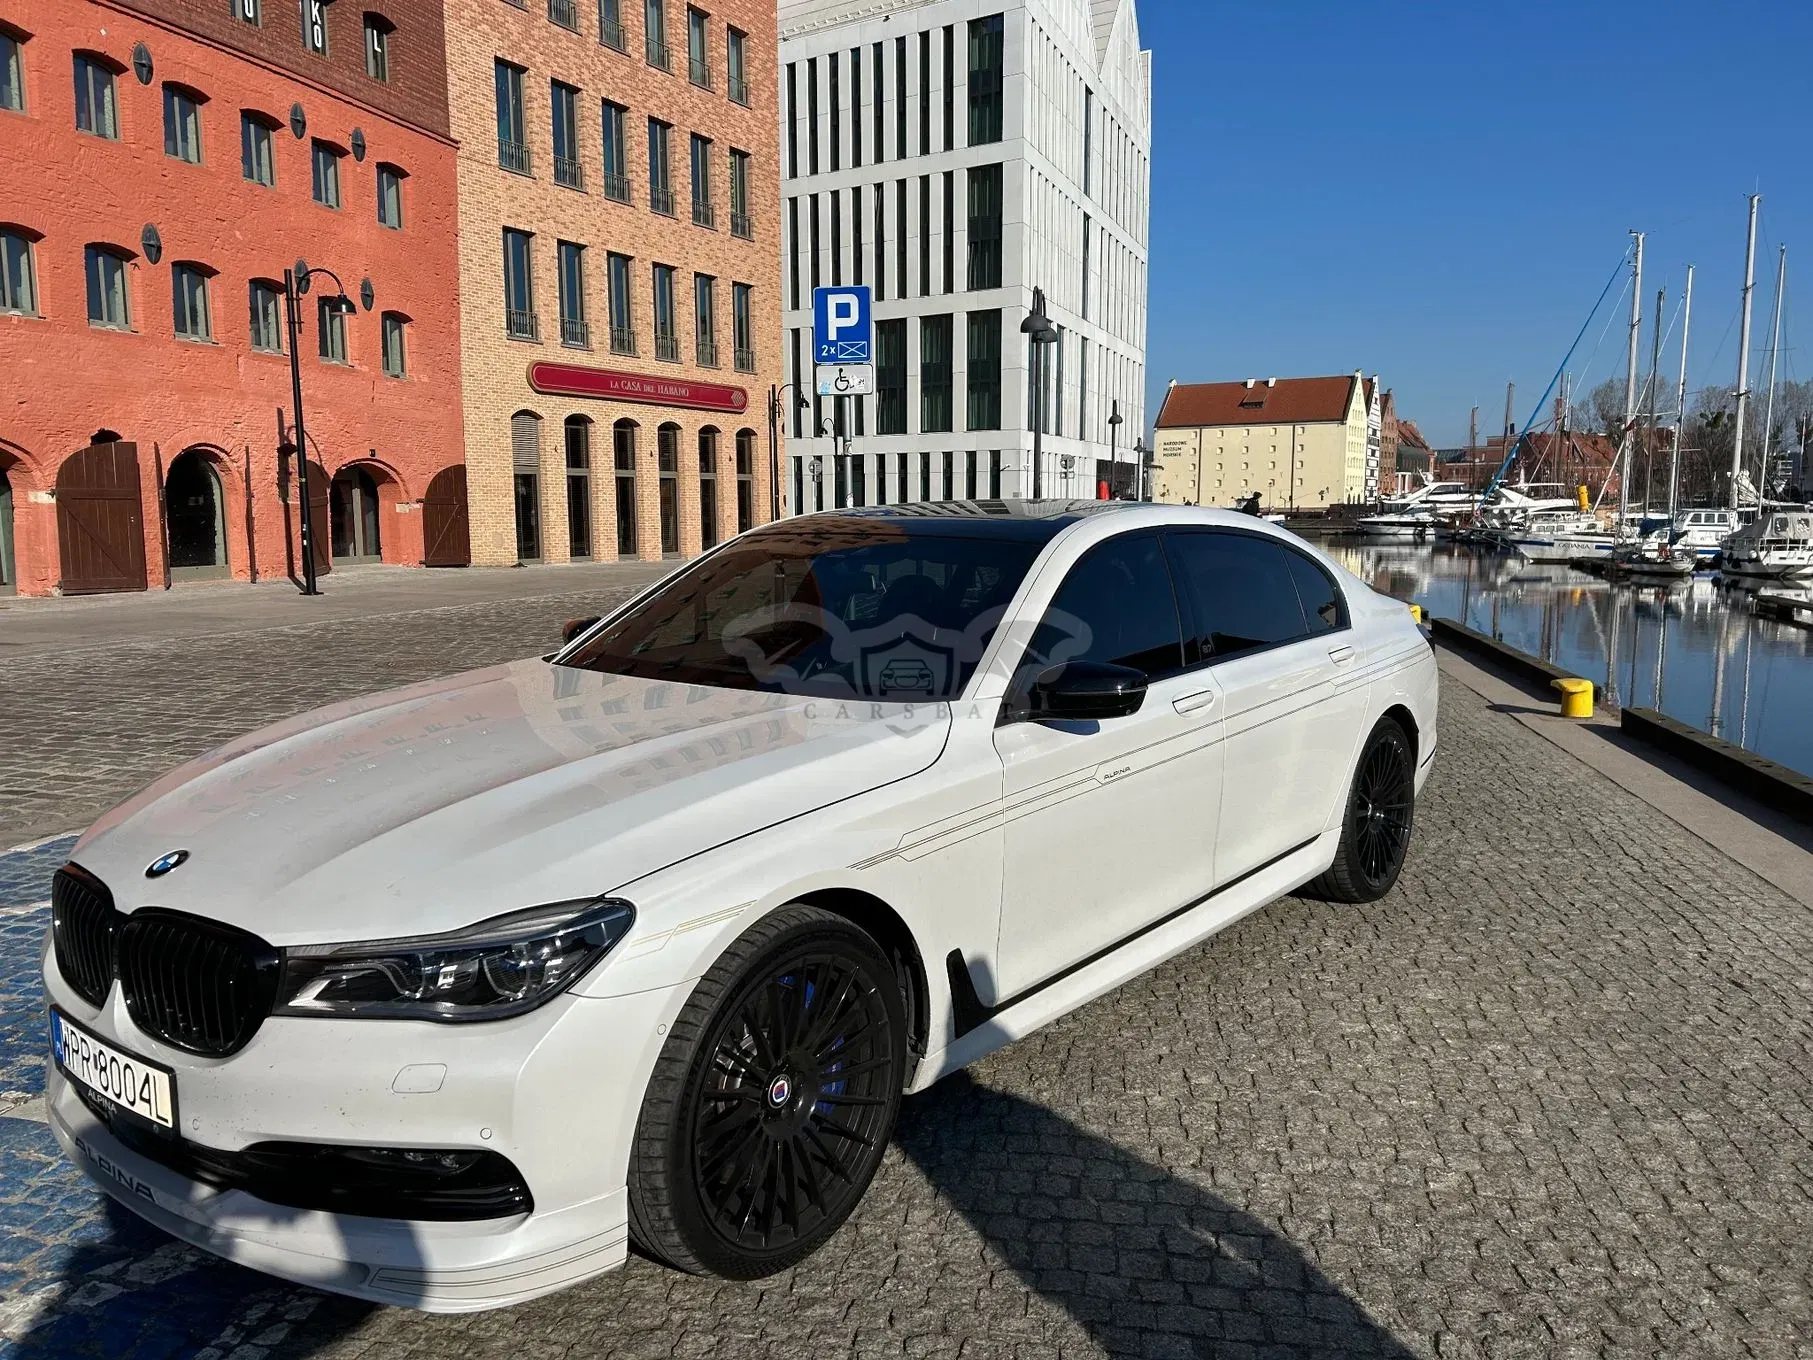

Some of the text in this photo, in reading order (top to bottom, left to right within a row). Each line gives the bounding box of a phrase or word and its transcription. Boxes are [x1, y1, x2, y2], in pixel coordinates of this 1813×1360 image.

[827, 293, 859, 341] P
[610, 380, 619, 389] LA
[621, 380, 641, 392] CASA
[657, 384, 689, 397] HABANO
[1104, 766, 1131, 780] ALPINA
[87, 1088, 118, 1115] ALPINA
[99, 1049, 169, 1124] 8004L
[76, 1136, 155, 1201] ALPINA
